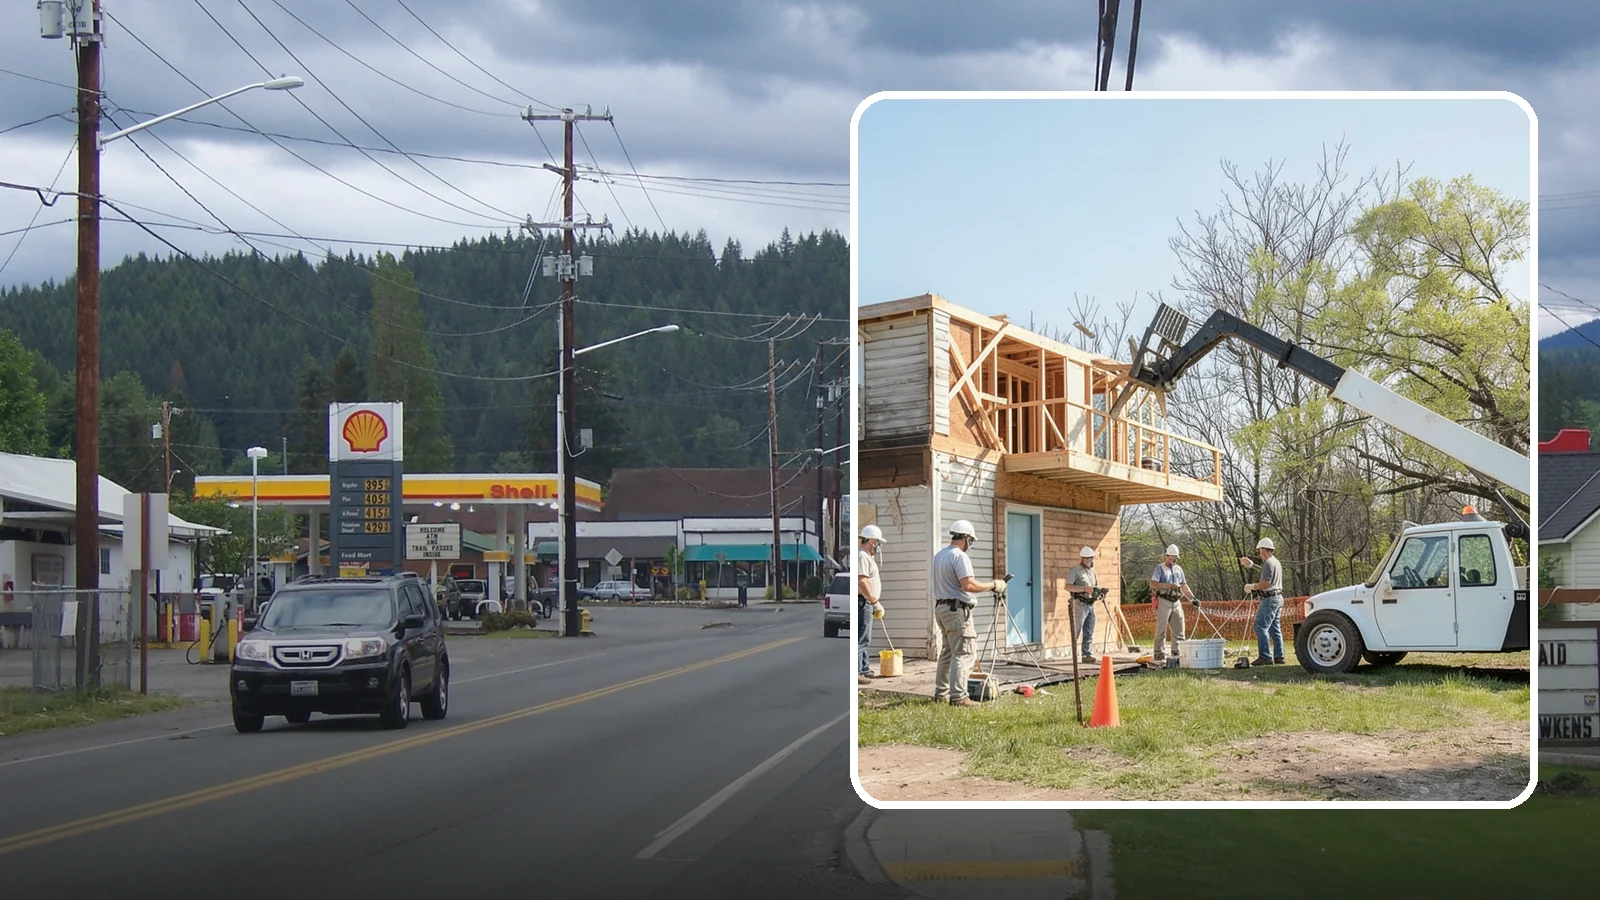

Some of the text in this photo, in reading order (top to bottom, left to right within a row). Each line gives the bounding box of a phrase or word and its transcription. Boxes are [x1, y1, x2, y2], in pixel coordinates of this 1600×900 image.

[366, 480, 384, 490] 395
[490, 484, 547, 499] Shell
[366, 494, 384, 504] 405
[366, 508, 384, 518] 415
[366, 522, 384, 532] 429
[1538, 643, 1567, 665] AID
